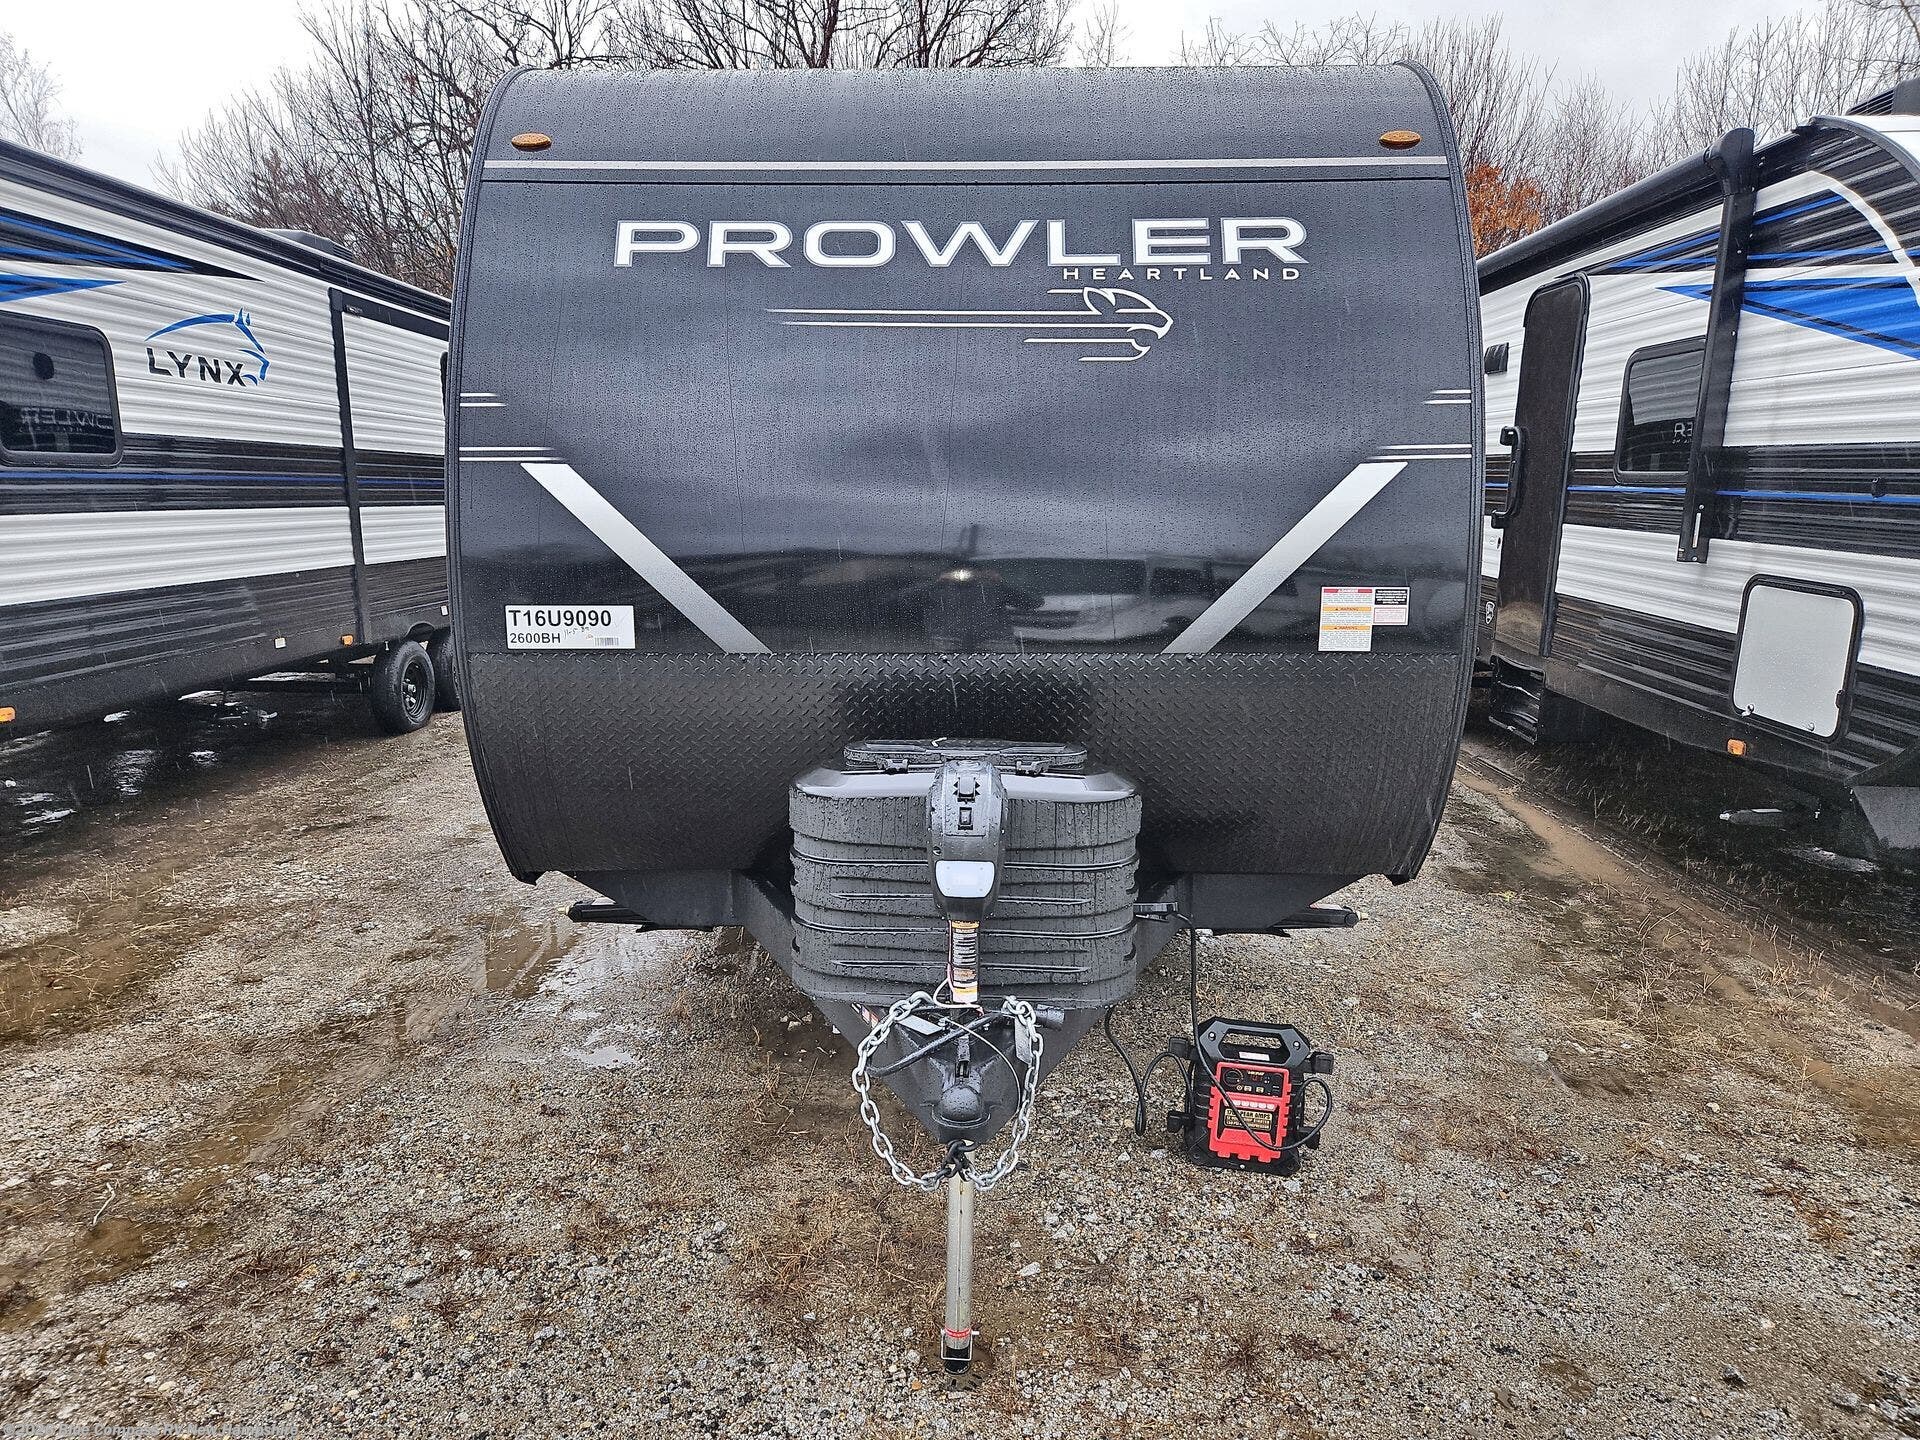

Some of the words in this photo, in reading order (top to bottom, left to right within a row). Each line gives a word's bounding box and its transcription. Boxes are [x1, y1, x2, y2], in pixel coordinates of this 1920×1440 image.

[613, 217, 1309, 267] PROWLER
[1063, 268, 1300, 280] HEARTLAND
[146, 347, 247, 387] LYNX
[508, 610, 612, 627] T16U9090
[510, 632, 561, 644] 2600BH
